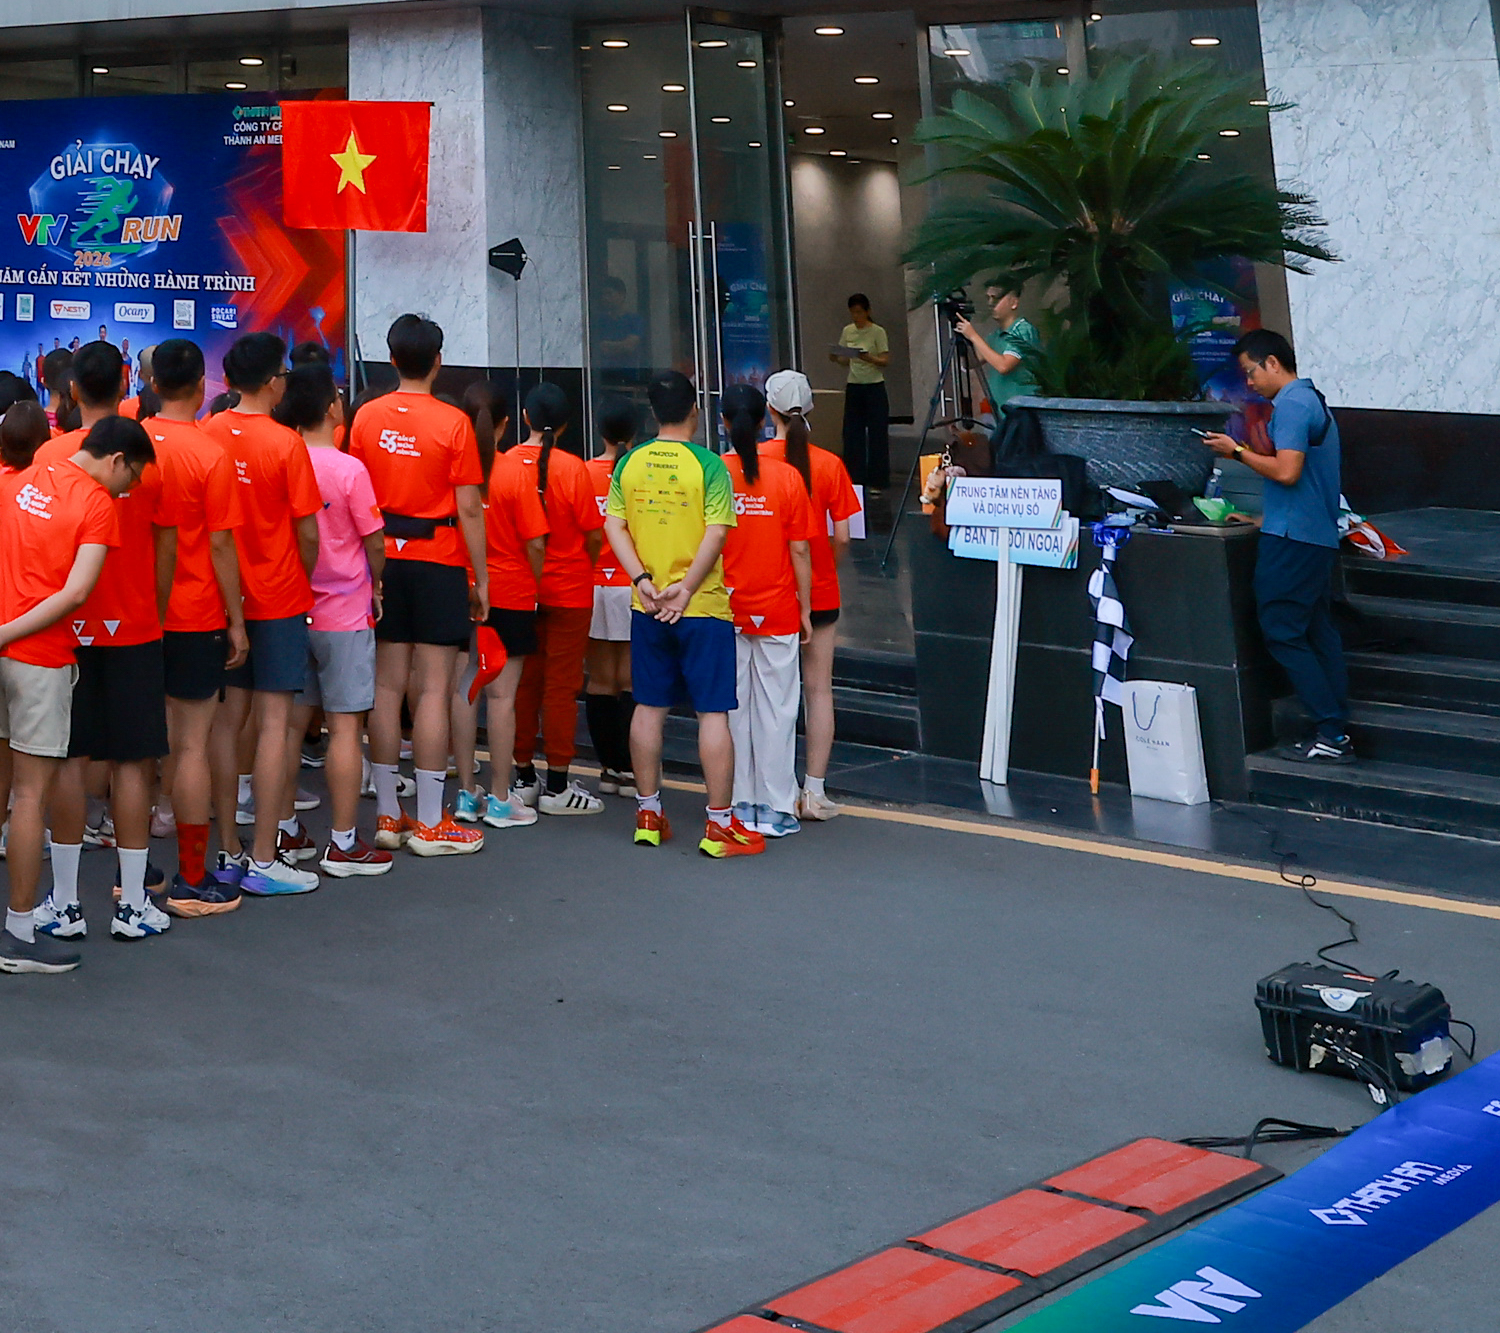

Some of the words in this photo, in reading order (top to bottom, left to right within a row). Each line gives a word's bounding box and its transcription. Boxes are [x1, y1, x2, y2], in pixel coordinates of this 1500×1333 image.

[260, 121, 271, 131] TY
[0, 140, 15, 149] NAM
[253, 135, 266, 145] AN
[50, 139, 93, 180] GIẢI
[100, 149, 160, 180] CHẠY
[17, 214, 68, 246] VTV
[121, 215, 182, 244] RUN
[27, 263, 59, 285] GẮN
[61, 264, 91, 286] KẾT
[94, 266, 151, 289] NHỮNG
[153, 270, 200, 290] HÀNH
[203, 271, 256, 292] TRÌNH
[119, 305, 151, 320] Ocany
[956, 486, 987, 498] TRUNG
[989, 485, 1009, 499] TÂM
[973, 500, 985, 514] VÀ
[988, 503, 1009, 517] DỊCH
[1011, 504, 1024, 518] VỤ
[964, 526, 986, 545] BAN
[1028, 533, 1063, 557] NGOẠI
[1432, 1163, 1473, 1186] MEDIA
